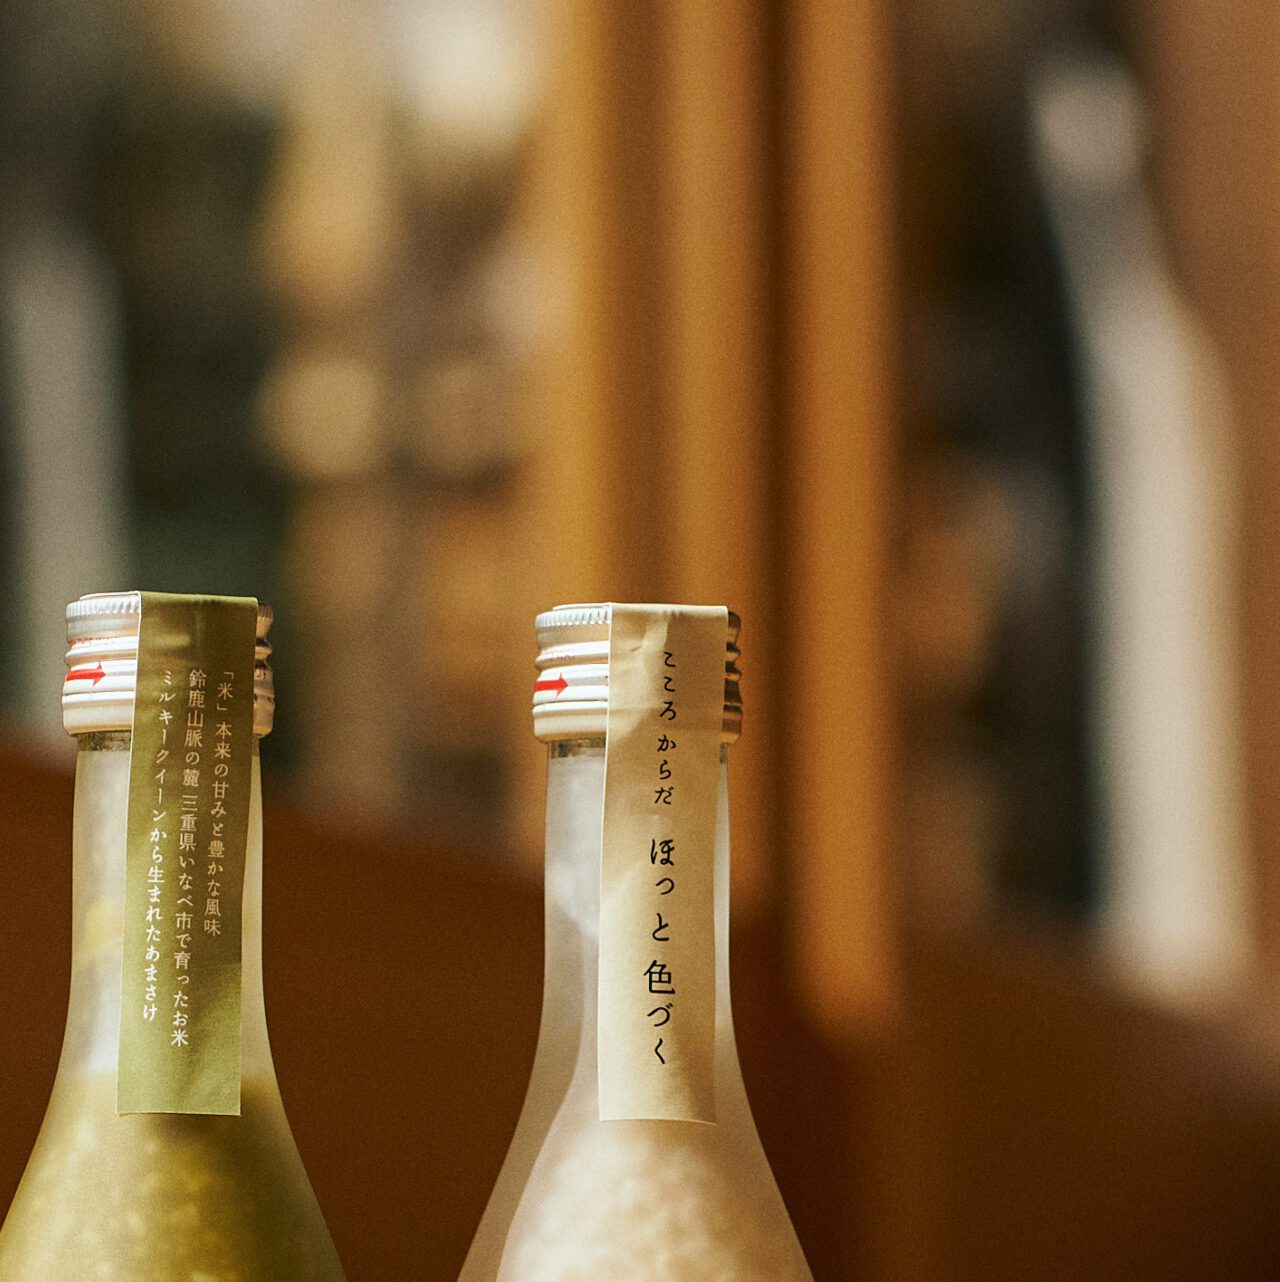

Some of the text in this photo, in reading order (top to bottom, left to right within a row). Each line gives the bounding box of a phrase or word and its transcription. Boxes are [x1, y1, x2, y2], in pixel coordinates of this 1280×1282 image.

[143, 671, 176, 1022] ミルキークイーンから生まれたあまさけ
